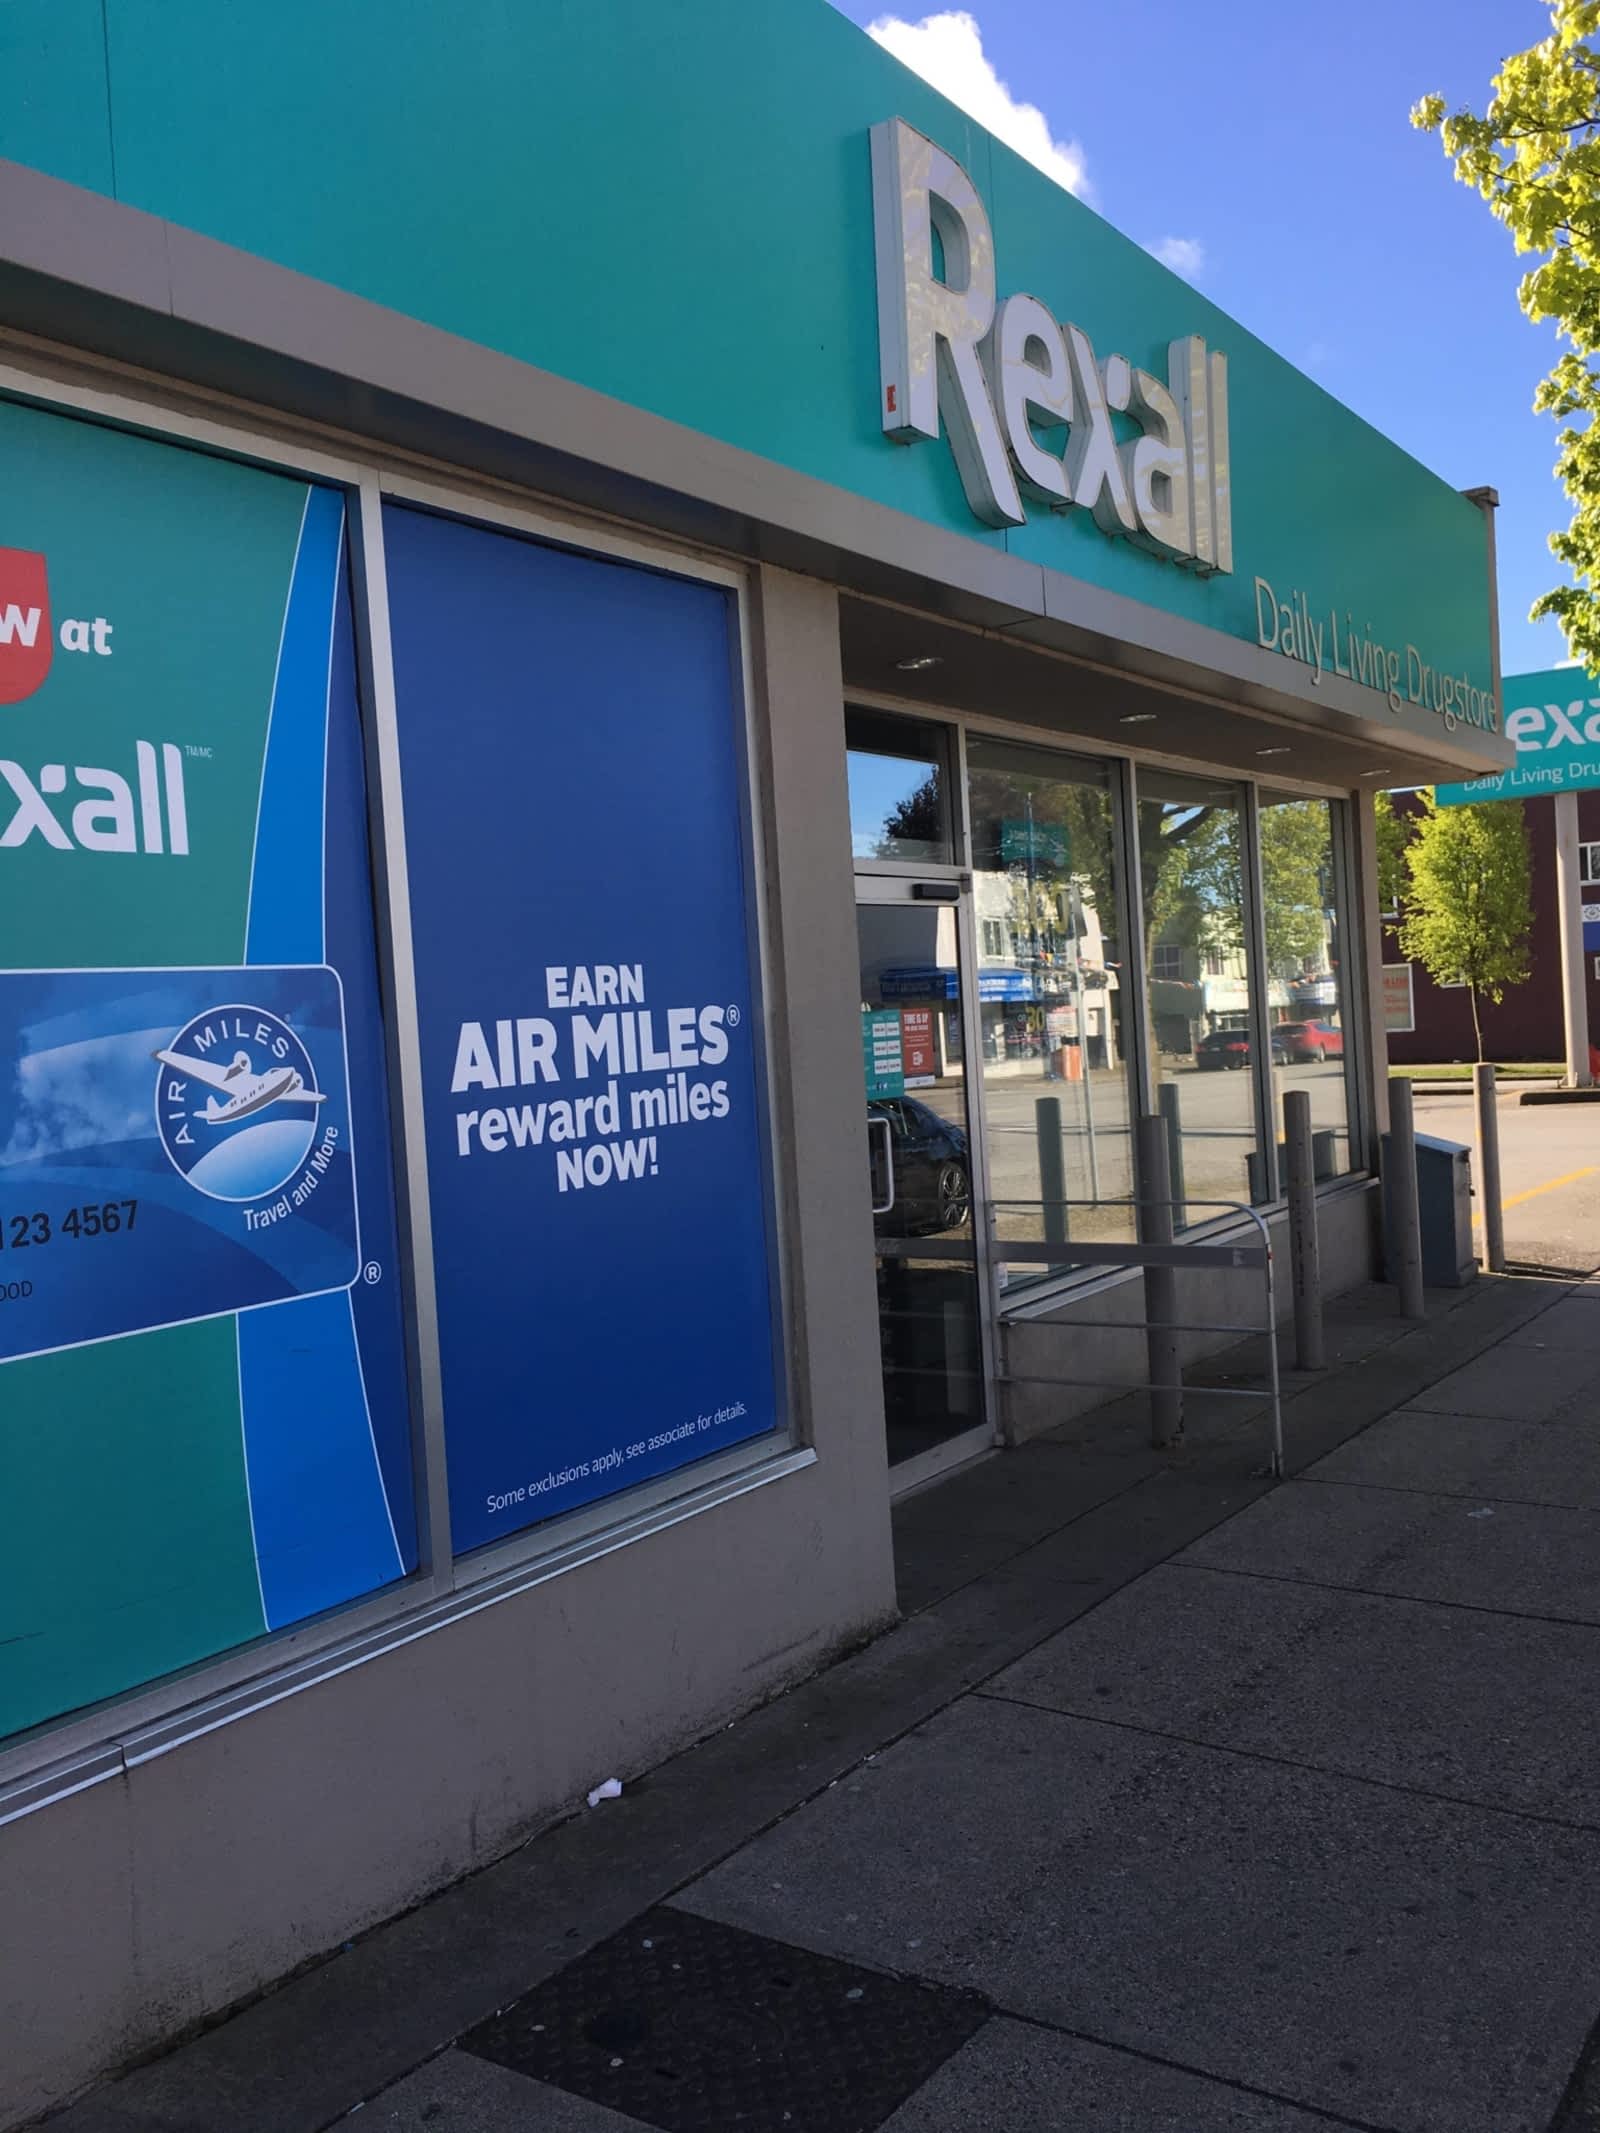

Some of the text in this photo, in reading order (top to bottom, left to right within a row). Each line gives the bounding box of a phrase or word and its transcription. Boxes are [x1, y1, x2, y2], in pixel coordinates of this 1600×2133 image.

[869, 115, 1232, 579] Rexall
[60, 617, 113, 655] at
[1255, 576, 1498, 732] Daily Living Drugstore
[1511, 763, 1563, 785] Living
[545, 963, 645, 1008] EARN
[168, 1018, 289, 1146] AIR MILES
[451, 1017, 560, 1093] AIR
[456, 1072, 730, 1156] reward miles
[243, 1125, 339, 1231] Travel and More
[556, 1136, 659, 1192] NOW!
[61, 1199, 138, 1239] 4567
[487, 1486, 525, 1513] Some
[528, 1460, 590, 1497] exclusions
[592, 1448, 625, 1474] apply,
[626, 1441, 646, 1459] see
[648, 1421, 695, 1451] associate
[697, 1414, 712, 1432] for
